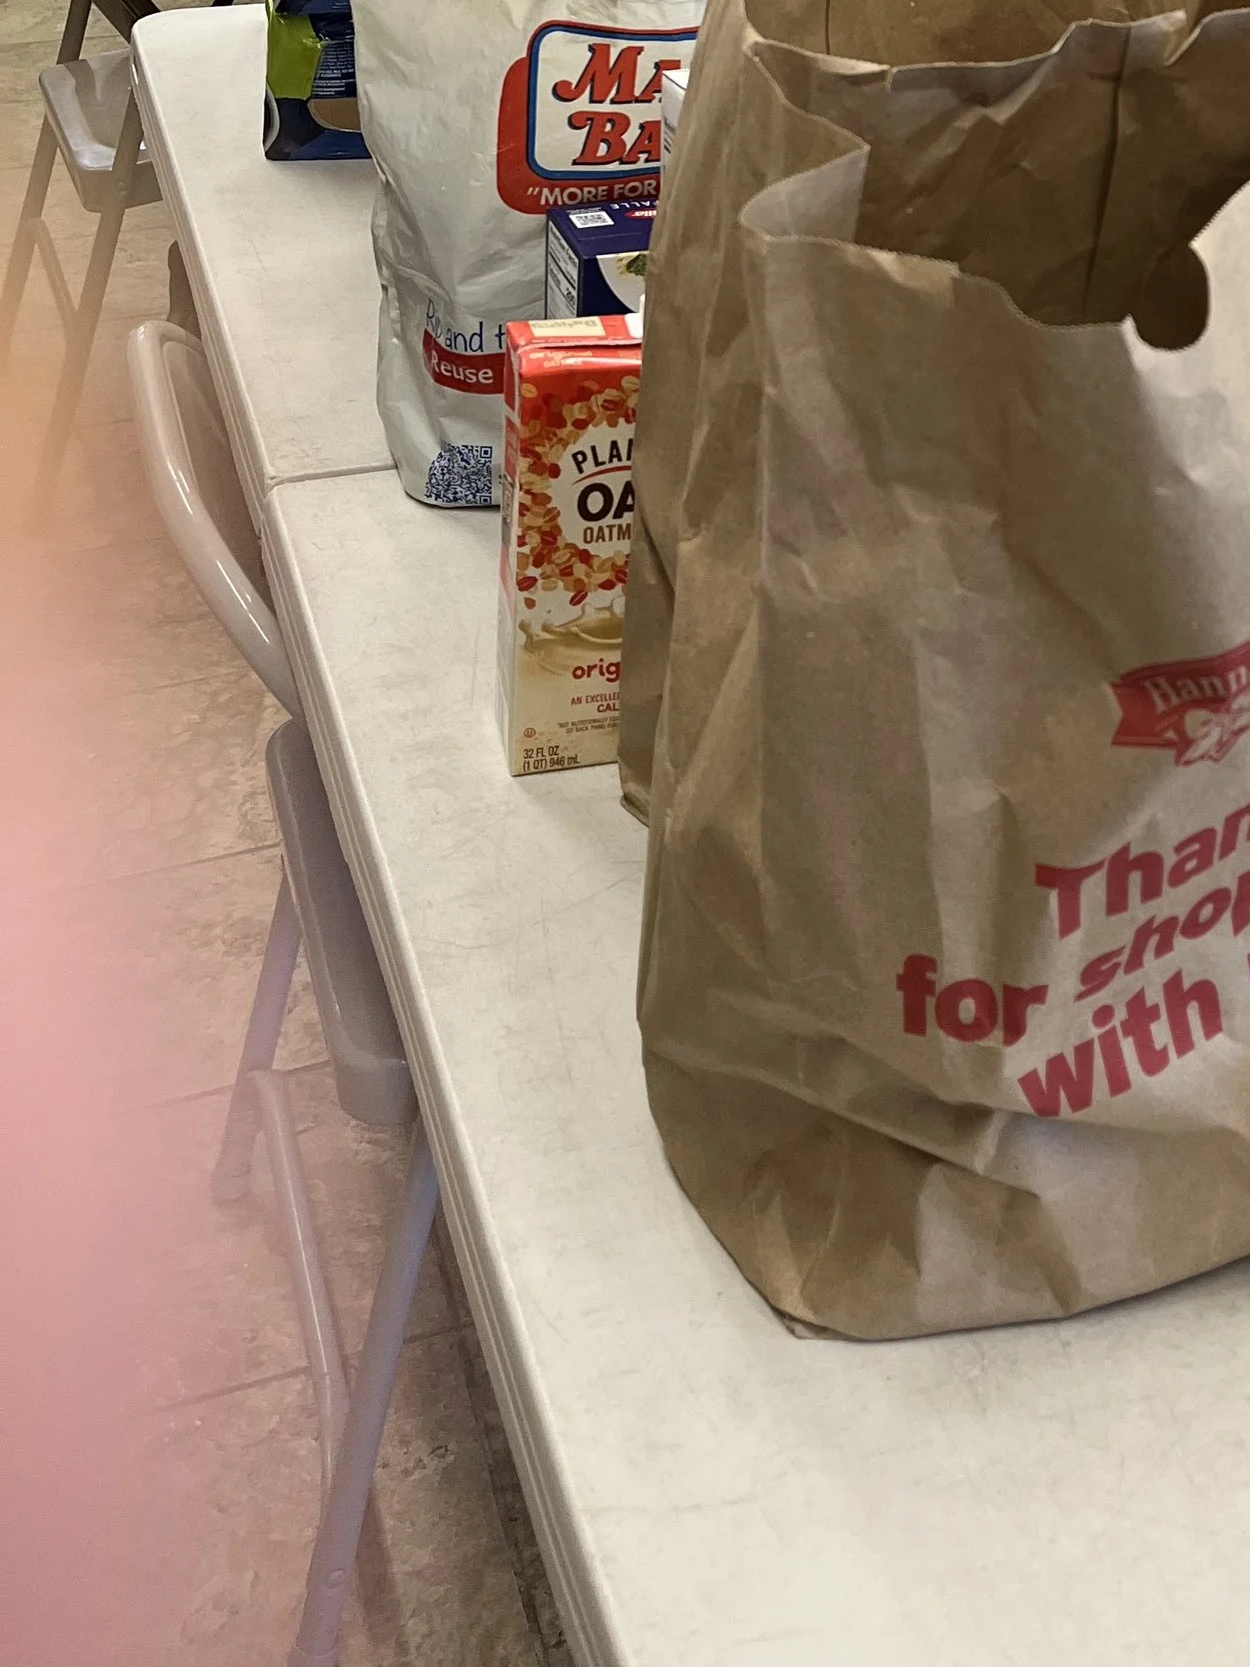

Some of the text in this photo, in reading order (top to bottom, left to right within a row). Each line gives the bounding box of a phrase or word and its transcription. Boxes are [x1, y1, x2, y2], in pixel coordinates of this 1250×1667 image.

[552, 42, 681, 104] MA
[567, 111, 661, 166] BA
[613, 180, 656, 198] FOR
[445, 321, 484, 353] and
[432, 354, 494, 384] Reuse
[577, 480, 635, 522] OA
[583, 522, 631, 545] OATM
[572, 657, 620, 683] orig
[571, 696, 582, 706] AN
[597, 703, 620, 713] CAL
[522, 753, 580, 772] (1 QT) 946 mL
[523, 745, 560, 760] 32 FL OZ
[896, 953, 1049, 1047] for
[1017, 968, 1224, 1117] with
